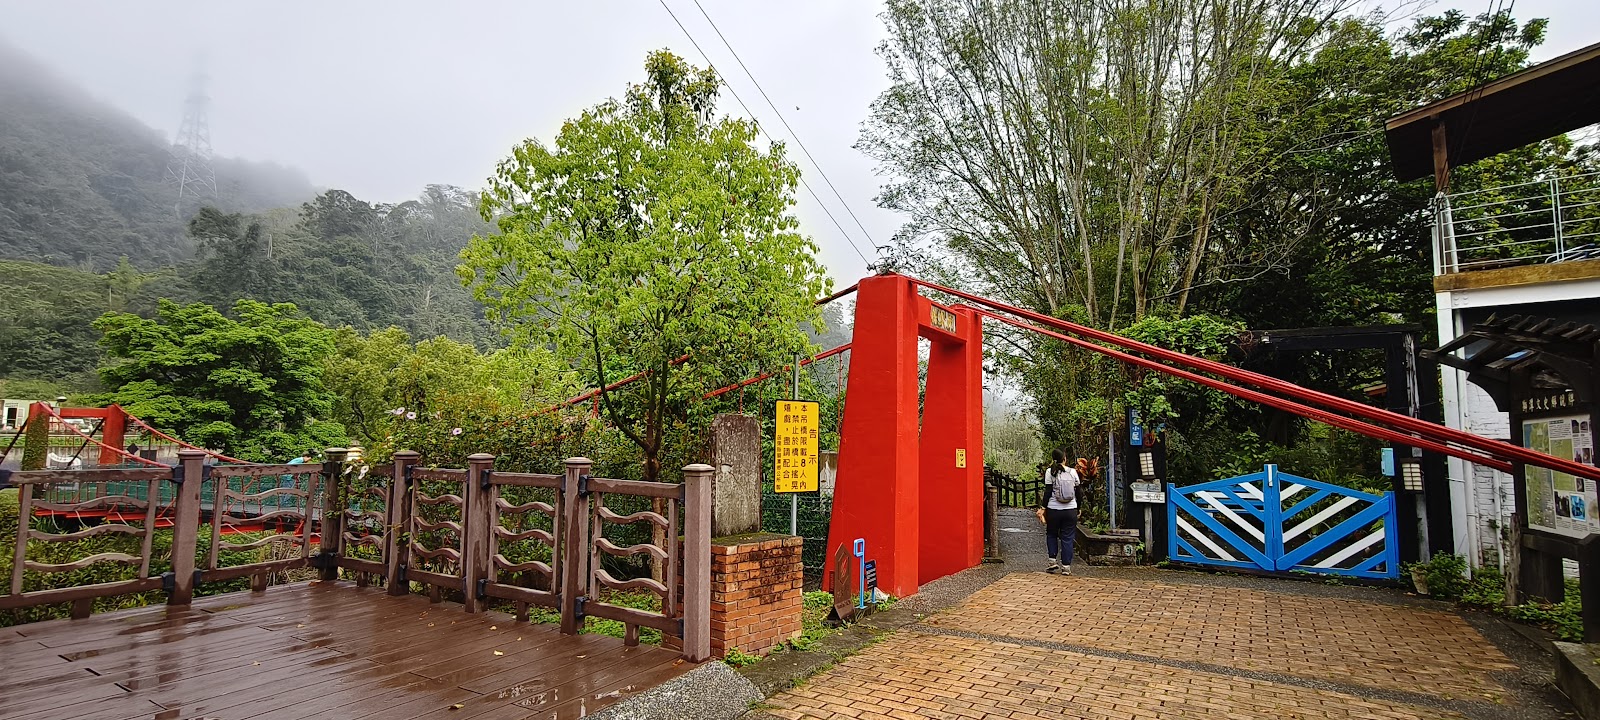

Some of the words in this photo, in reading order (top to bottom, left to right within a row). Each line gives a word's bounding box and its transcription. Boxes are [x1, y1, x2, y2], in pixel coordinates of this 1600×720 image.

[799, 404, 808, 490] 本吊橋限載8人內
[809, 428, 817, 465] 告示
